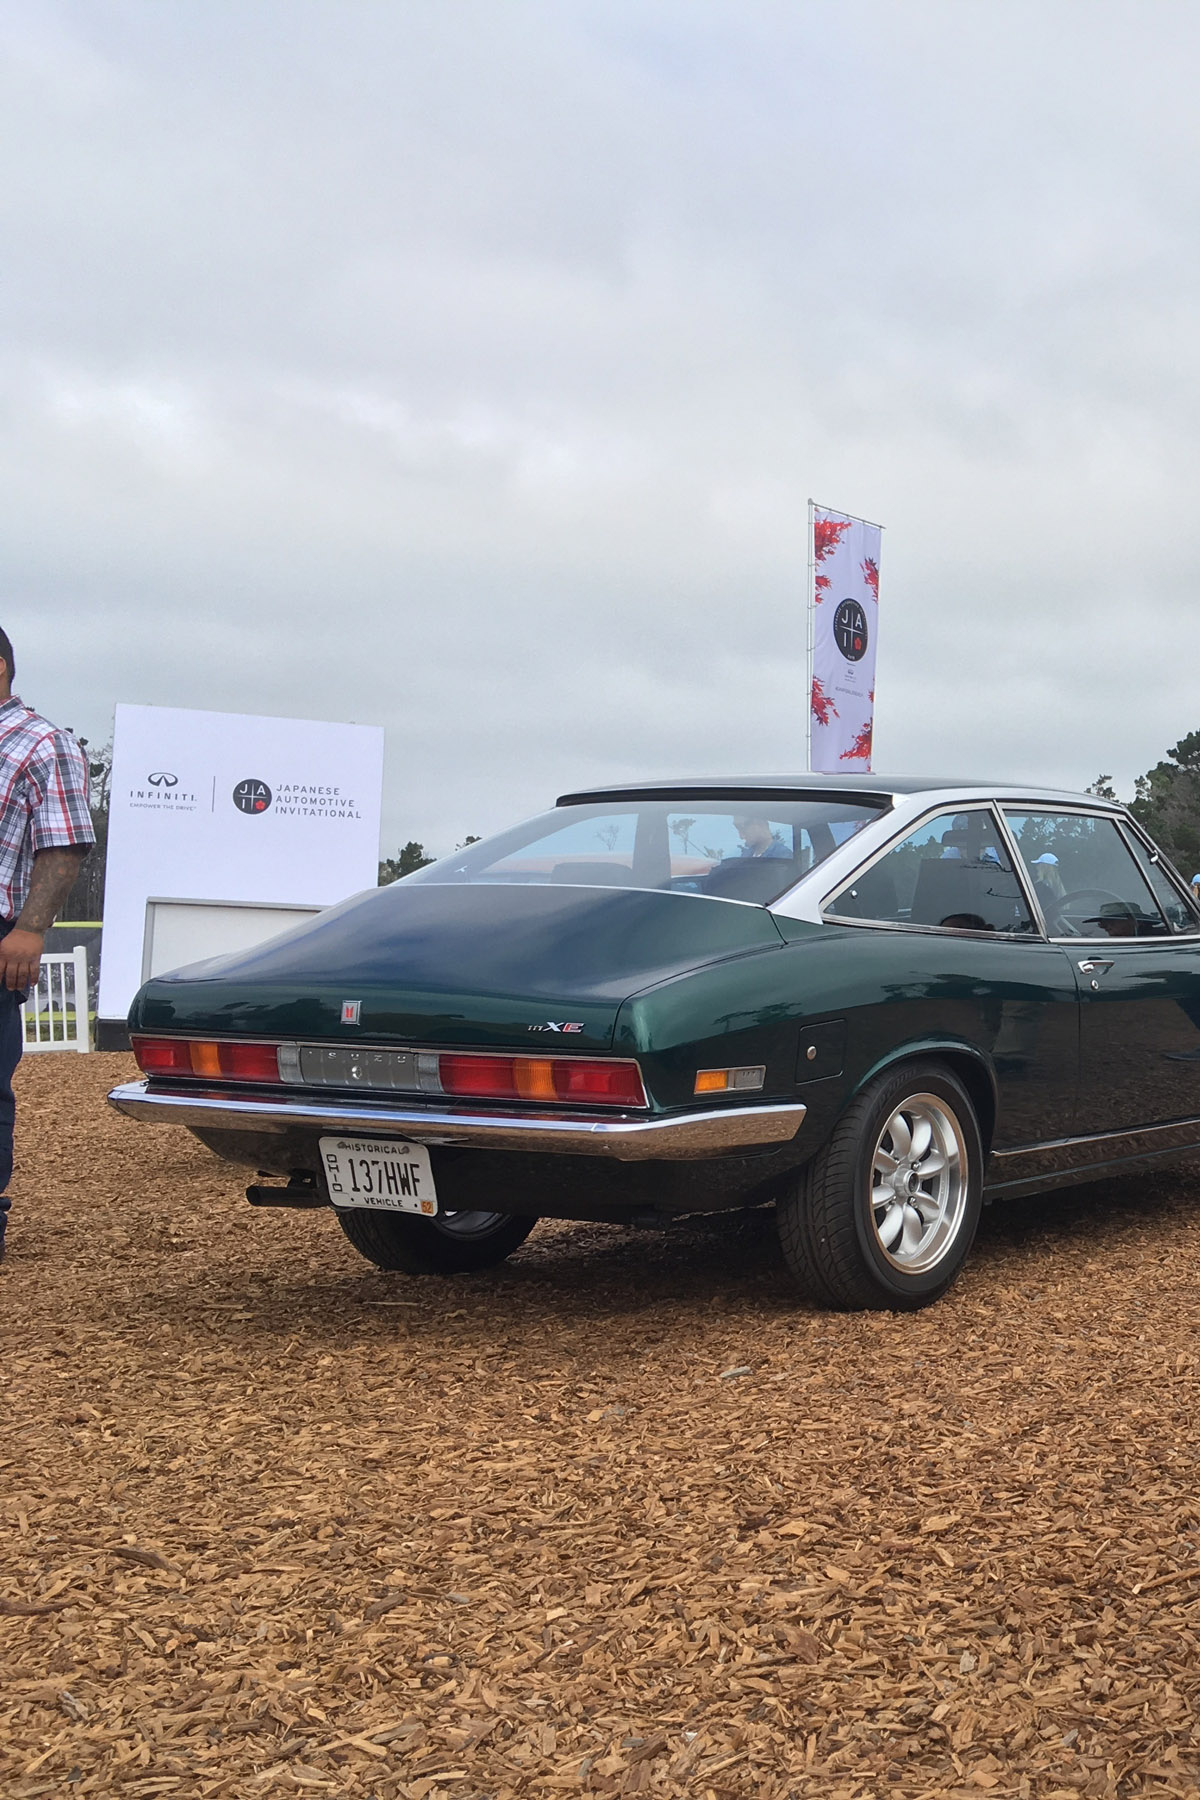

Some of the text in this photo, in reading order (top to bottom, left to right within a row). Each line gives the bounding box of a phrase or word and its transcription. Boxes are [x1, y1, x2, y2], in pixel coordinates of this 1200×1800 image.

[130, 790, 194, 801] INFINITI
[276, 784, 340, 796] JAPANESE
[275, 795, 355, 808] AUTOMOTIVE
[275, 806, 361, 819] INVITATIONAL
[344, 1143, 403, 1154] HISTORICAL
[326, 1154, 343, 1192] OHIO
[348, 1158, 420, 1197] 137HWF
[364, 1196, 403, 1208] VEHICLE
